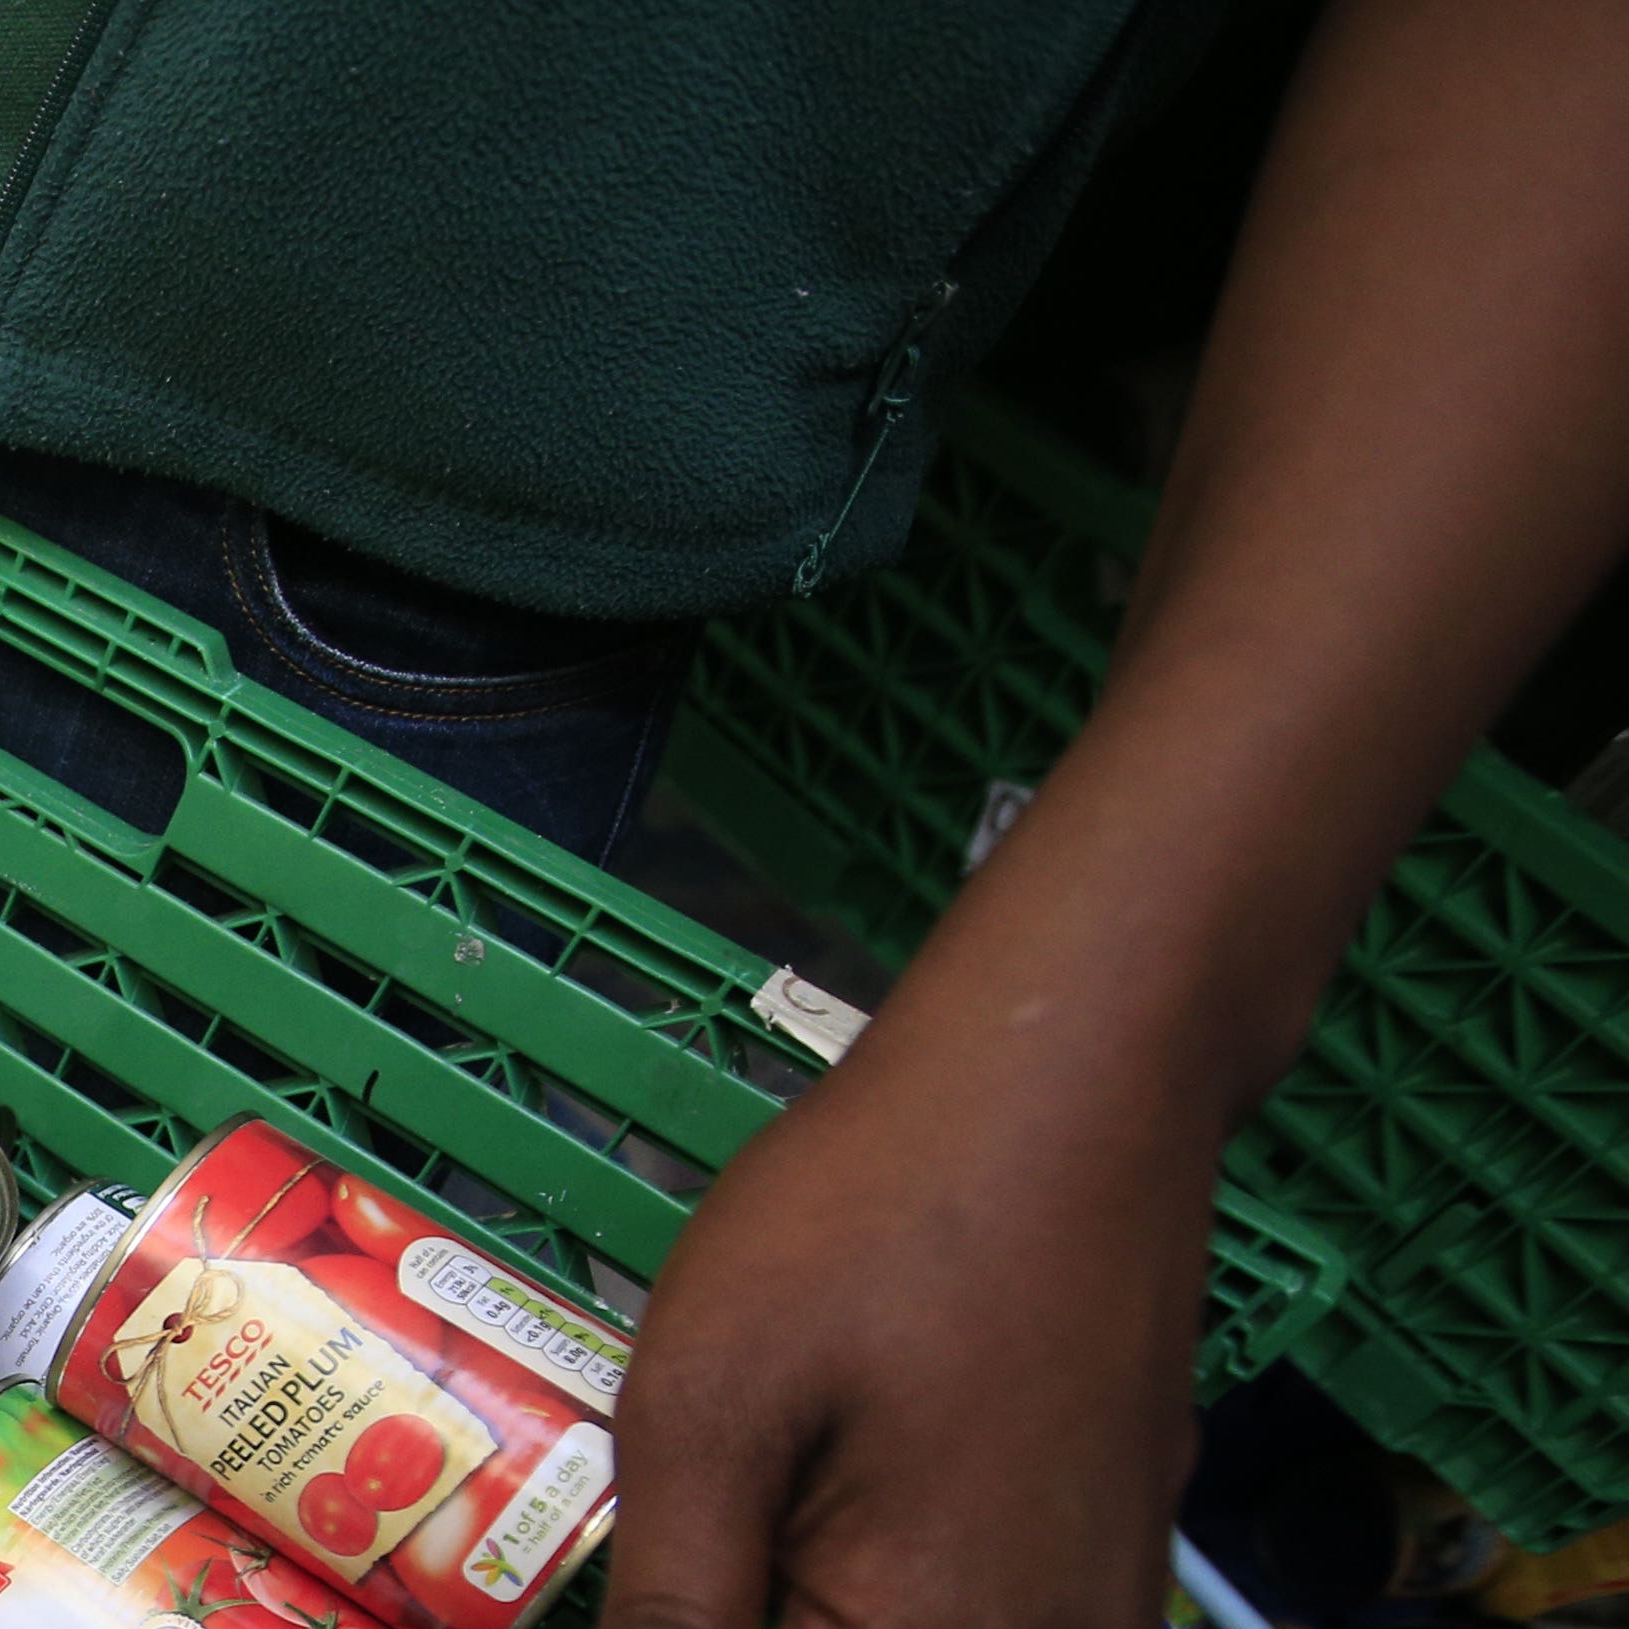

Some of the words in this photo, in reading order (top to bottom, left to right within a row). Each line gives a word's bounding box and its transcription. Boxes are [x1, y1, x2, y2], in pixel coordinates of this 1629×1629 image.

[55, 1229, 97, 1269] ingredients
[32, 1295, 53, 1319] Citric
[32, 1303, 63, 1338] Organic
[524, 1321, 551, 1342] <0.1g
[12, 1335, 39, 1368] Tomato
[180, 1314, 269, 1402] TESCO
[211, 1394, 291, 1483] PEELED
[282, 1326, 364, 1406] PLUM
[218, 1352, 292, 1429] ITALIAN
[256, 1383, 347, 1475] TOMATOES
[270, 1467, 298, 1495] rich
[290, 1417, 346, 1473] tomato
[343, 1377, 386, 1423] sauce
[511, 1510, 537, 1536] of
[552, 1448, 590, 1485] day
[528, 1519, 552, 1546] half
[568, 1472, 591, 1499] can
